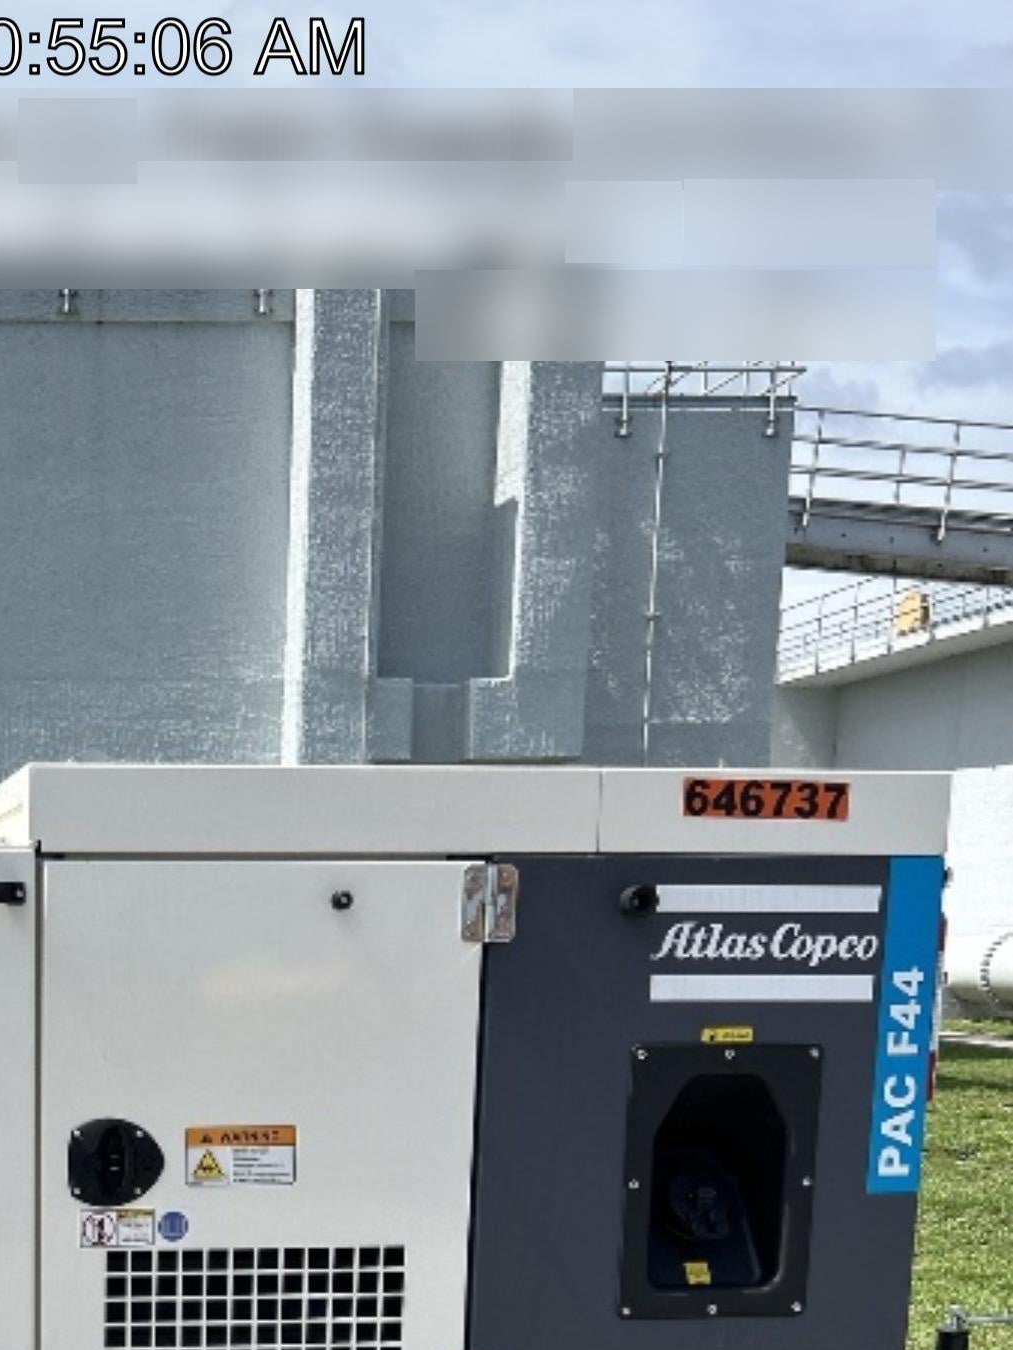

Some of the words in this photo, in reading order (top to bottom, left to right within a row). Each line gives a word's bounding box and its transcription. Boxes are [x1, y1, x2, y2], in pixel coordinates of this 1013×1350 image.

[685, 780, 848, 819] 646737
[650, 921, 769, 961] Atlas
[769, 922, 879, 967] Copco
[887, 966, 925, 1055] F44
[878, 1074, 917, 1177] PAC
